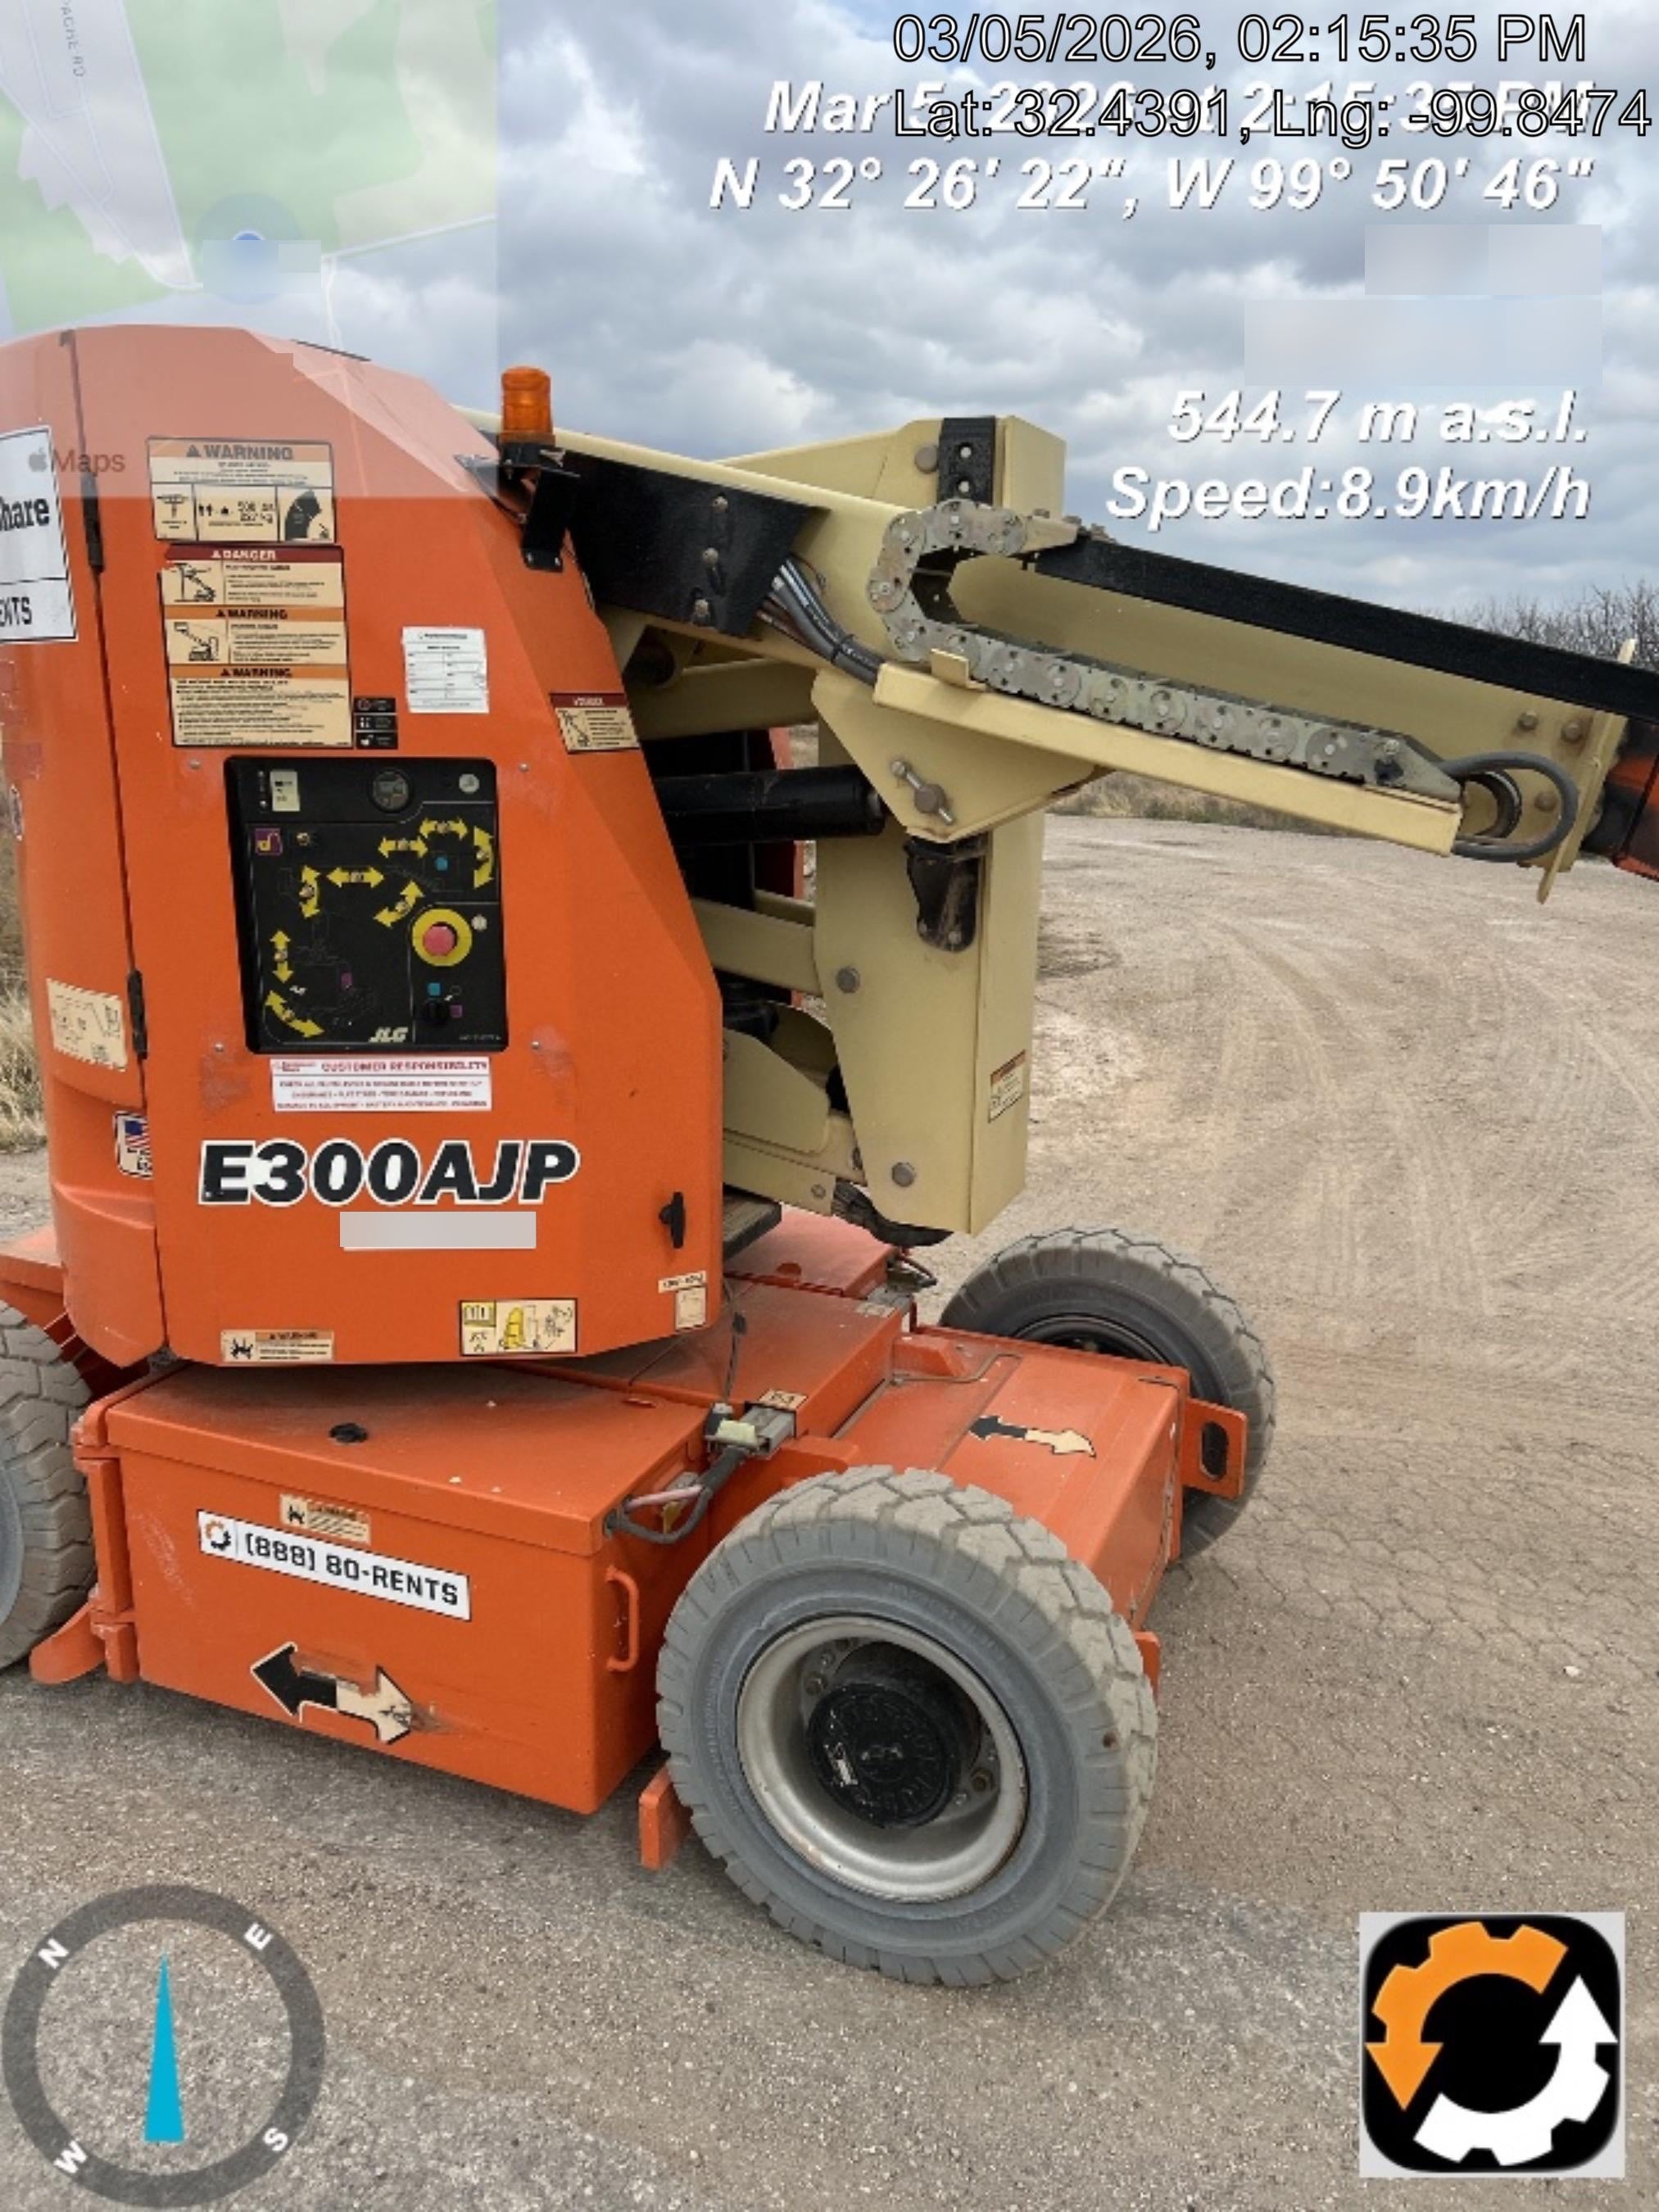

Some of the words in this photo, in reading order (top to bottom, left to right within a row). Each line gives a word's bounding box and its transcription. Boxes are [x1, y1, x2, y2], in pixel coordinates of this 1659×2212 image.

[204, 445, 292, 460] WARNING
[223, 550, 275, 560] DANGER
[228, 610, 288, 619] WARNING
[368, 1027, 408, 1043] JLG
[320, 1061, 387, 1072] CUSTOMER
[197, 1137, 580, 1208] E300AJP
[326, 1554, 459, 1607] 80-RENTS
